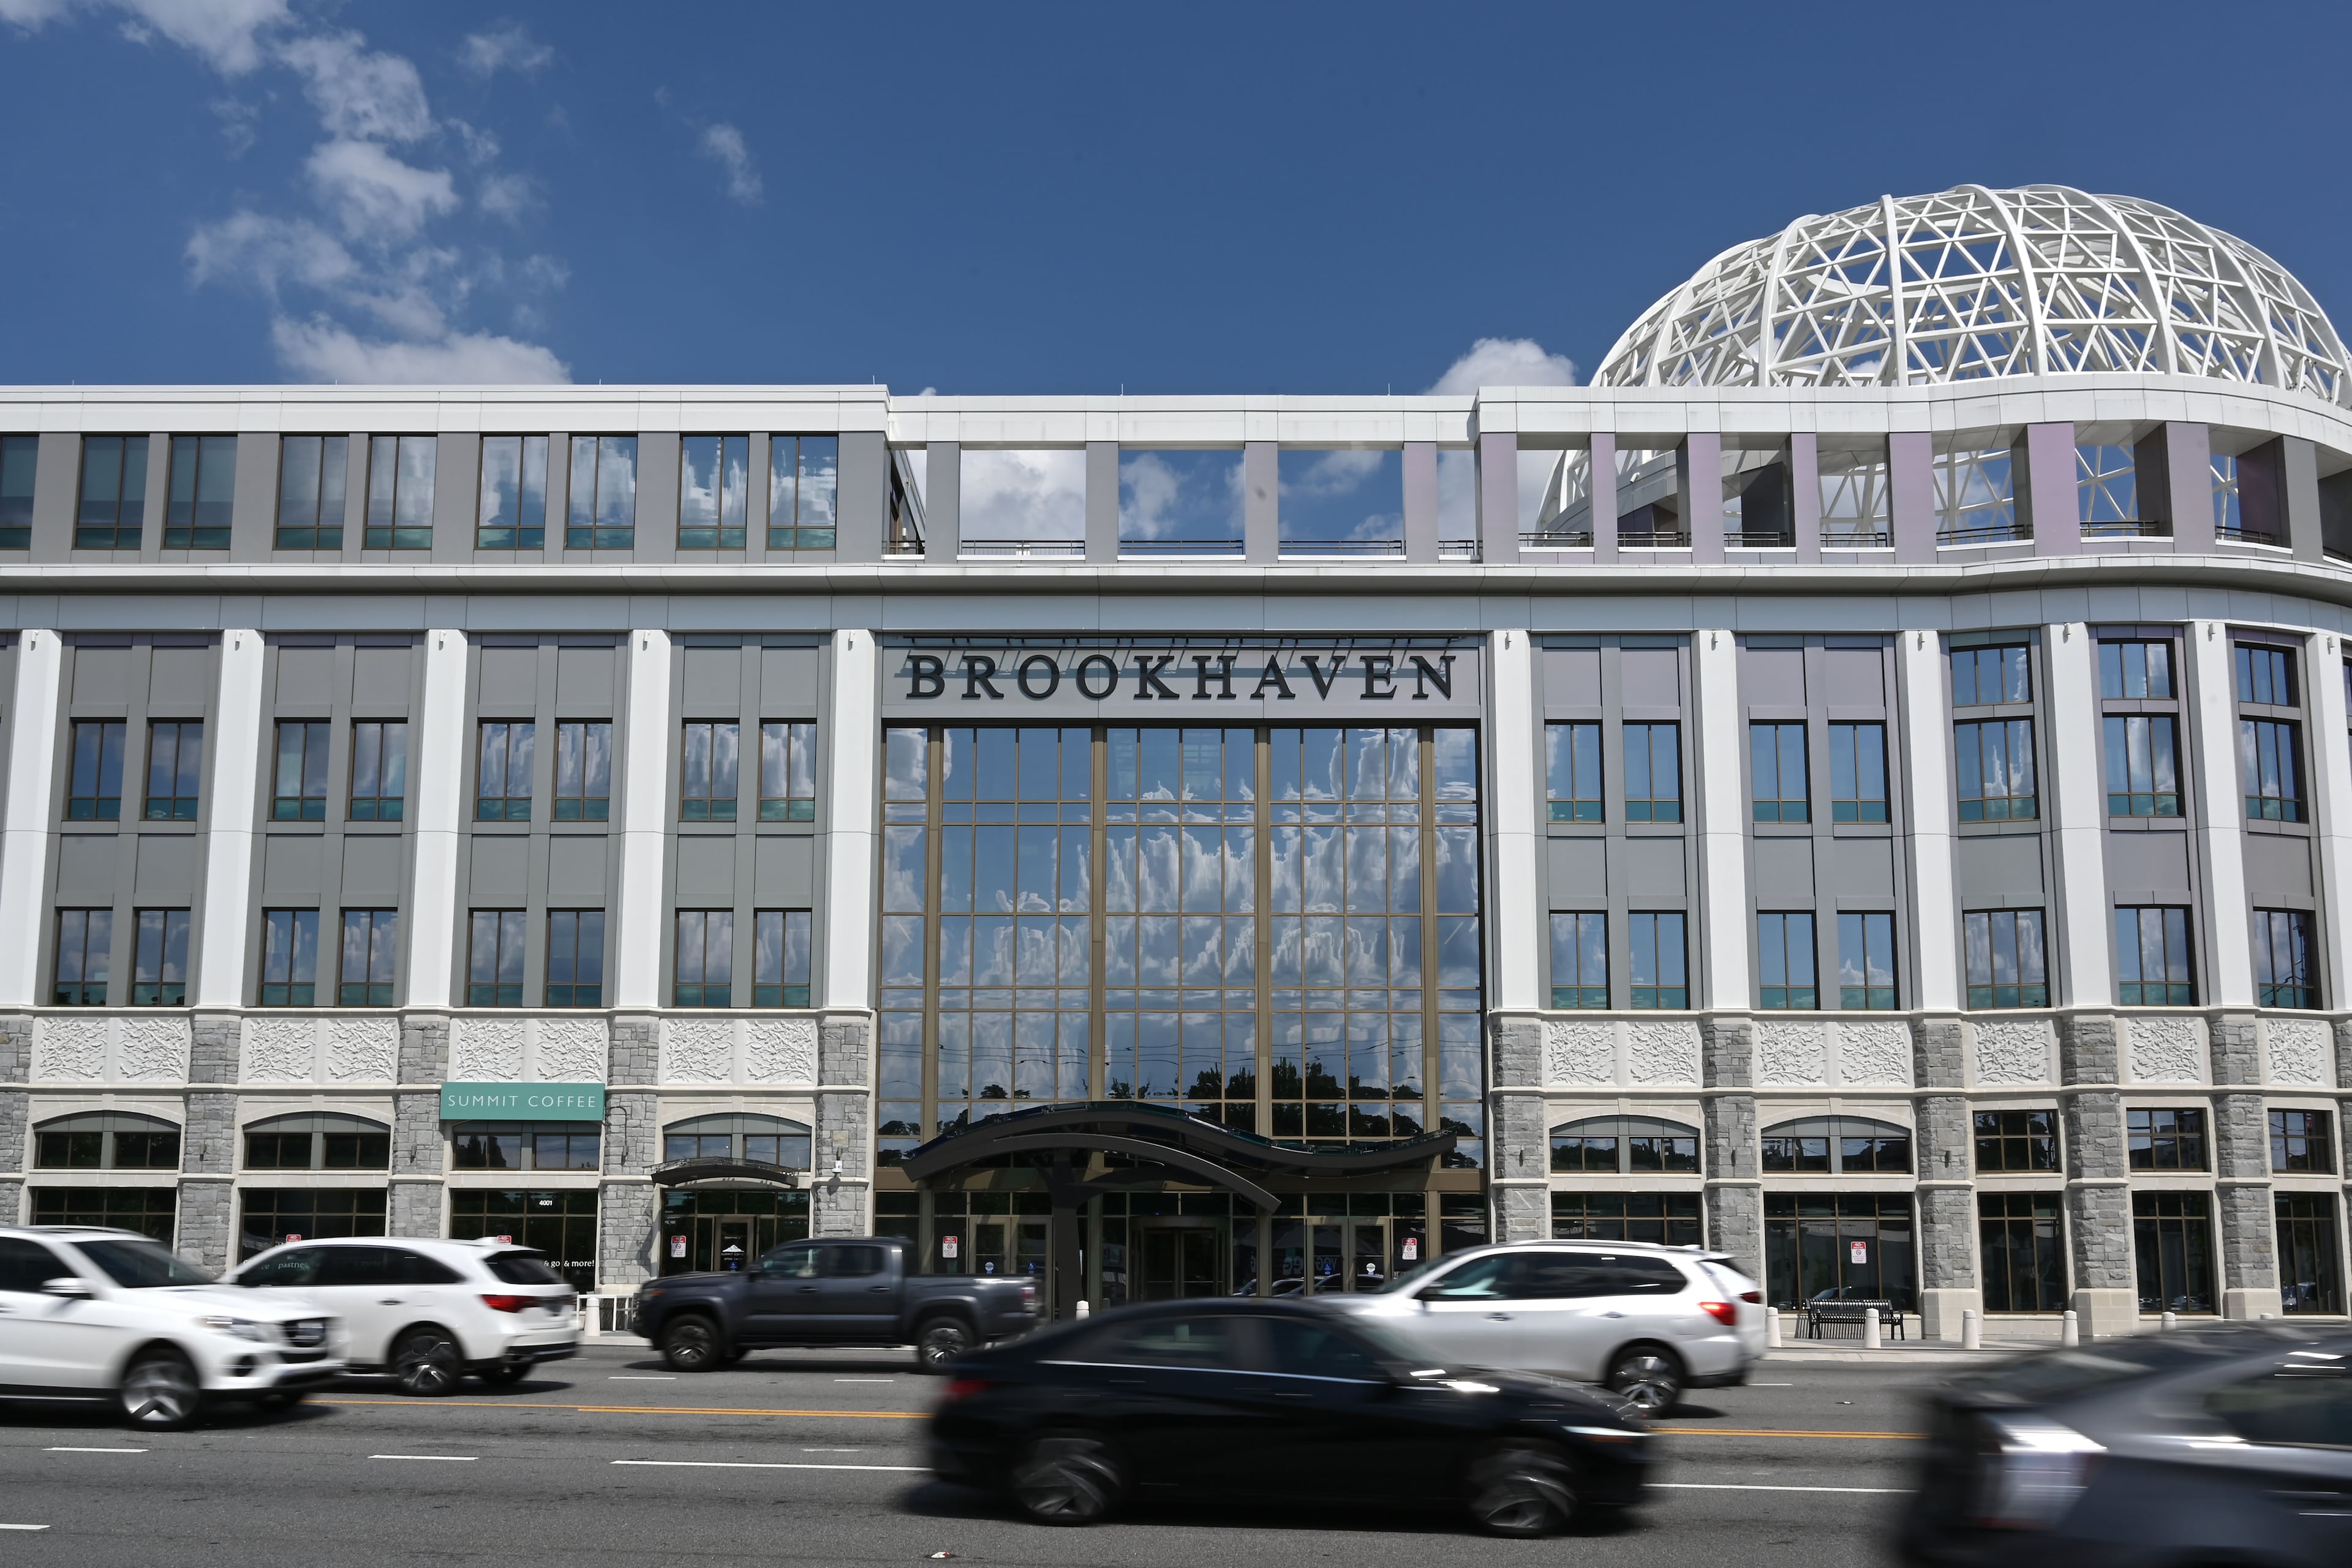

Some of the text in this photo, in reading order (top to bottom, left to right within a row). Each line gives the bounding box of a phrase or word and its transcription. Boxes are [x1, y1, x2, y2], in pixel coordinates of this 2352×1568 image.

[906, 654, 1456, 700] BROOKHAVEN
[448, 1095, 596, 1107] SUMMIT COFFEE
